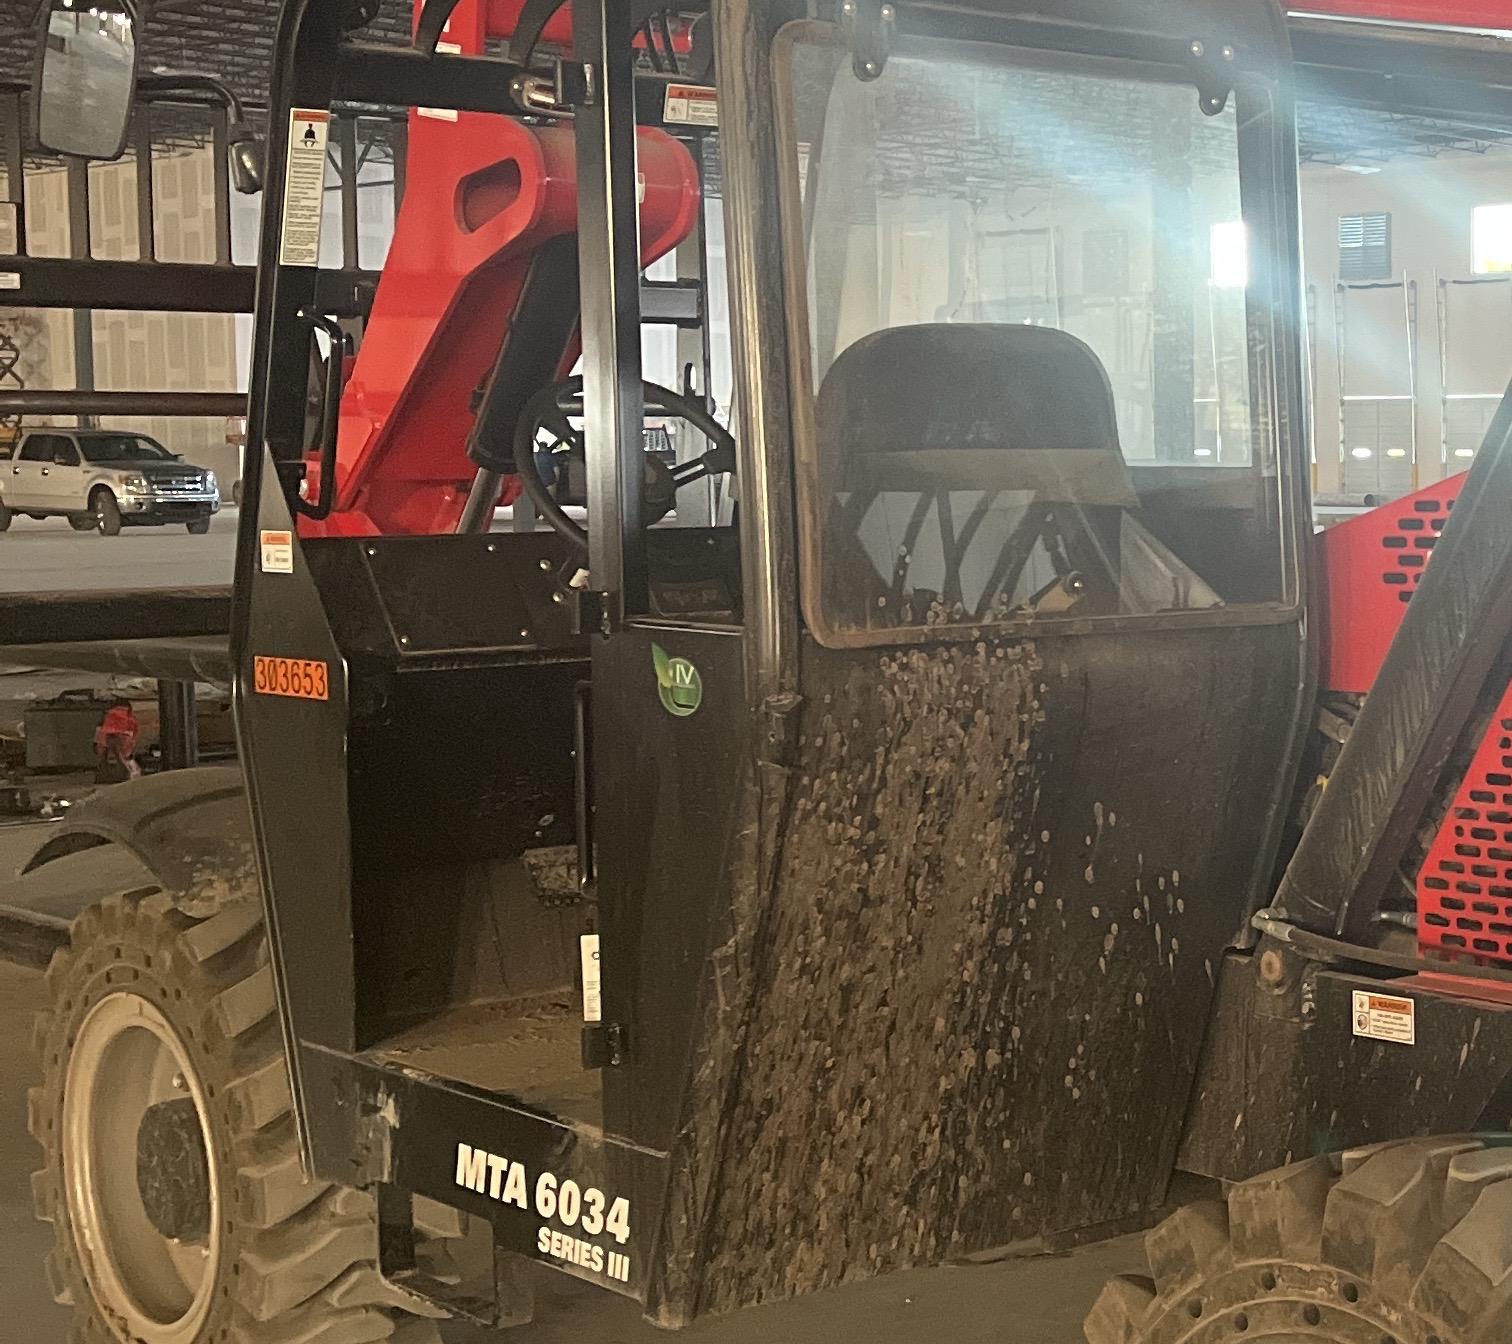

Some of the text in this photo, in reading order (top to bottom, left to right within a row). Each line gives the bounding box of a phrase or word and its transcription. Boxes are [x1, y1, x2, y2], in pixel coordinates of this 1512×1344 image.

[255, 658, 327, 697] 303653
[456, 1142, 631, 1245] MTA 6034
[537, 1226, 631, 1282] SERIES III
